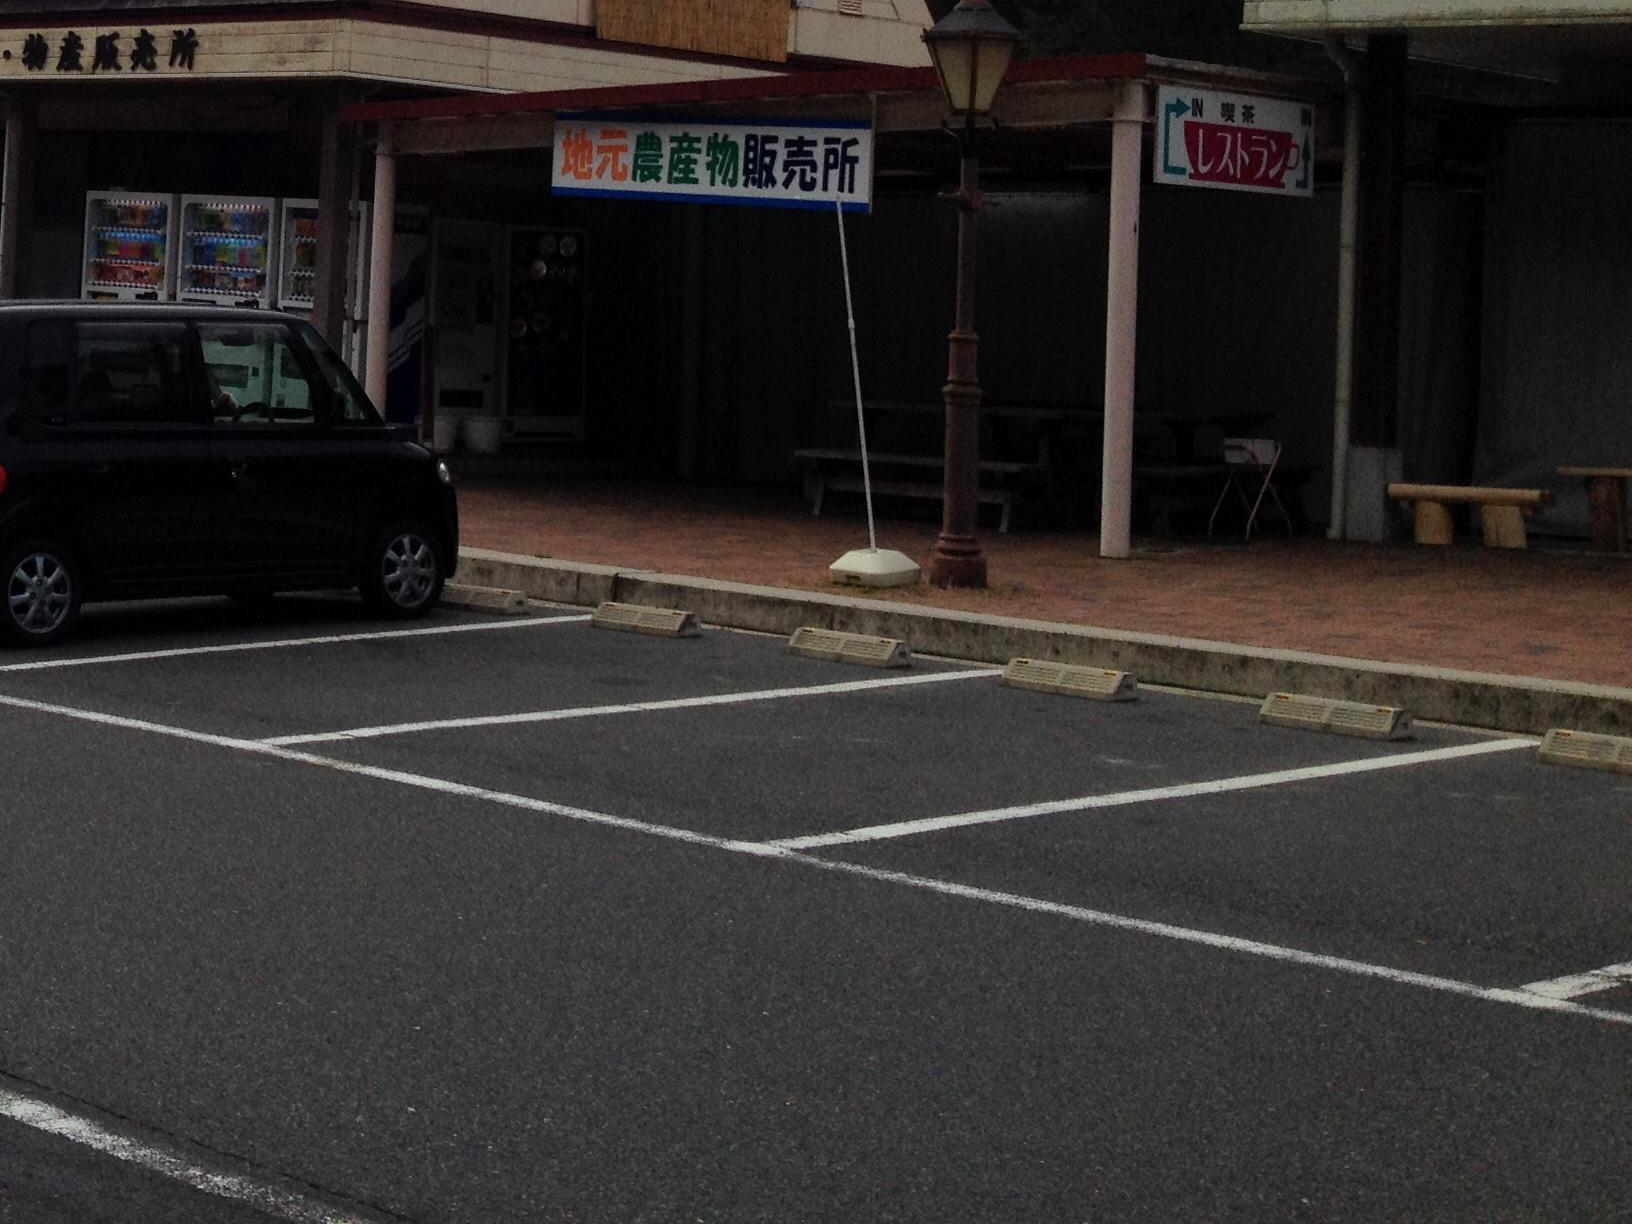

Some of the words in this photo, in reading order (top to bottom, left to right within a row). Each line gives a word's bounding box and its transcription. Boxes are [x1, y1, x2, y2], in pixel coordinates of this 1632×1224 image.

[1191, 97, 1203, 118] IN
[1220, 102, 1255, 123] 喫茶
[561, 129, 859, 194] 地元農産物販売所
[1198, 128, 1288, 179] レストラン
